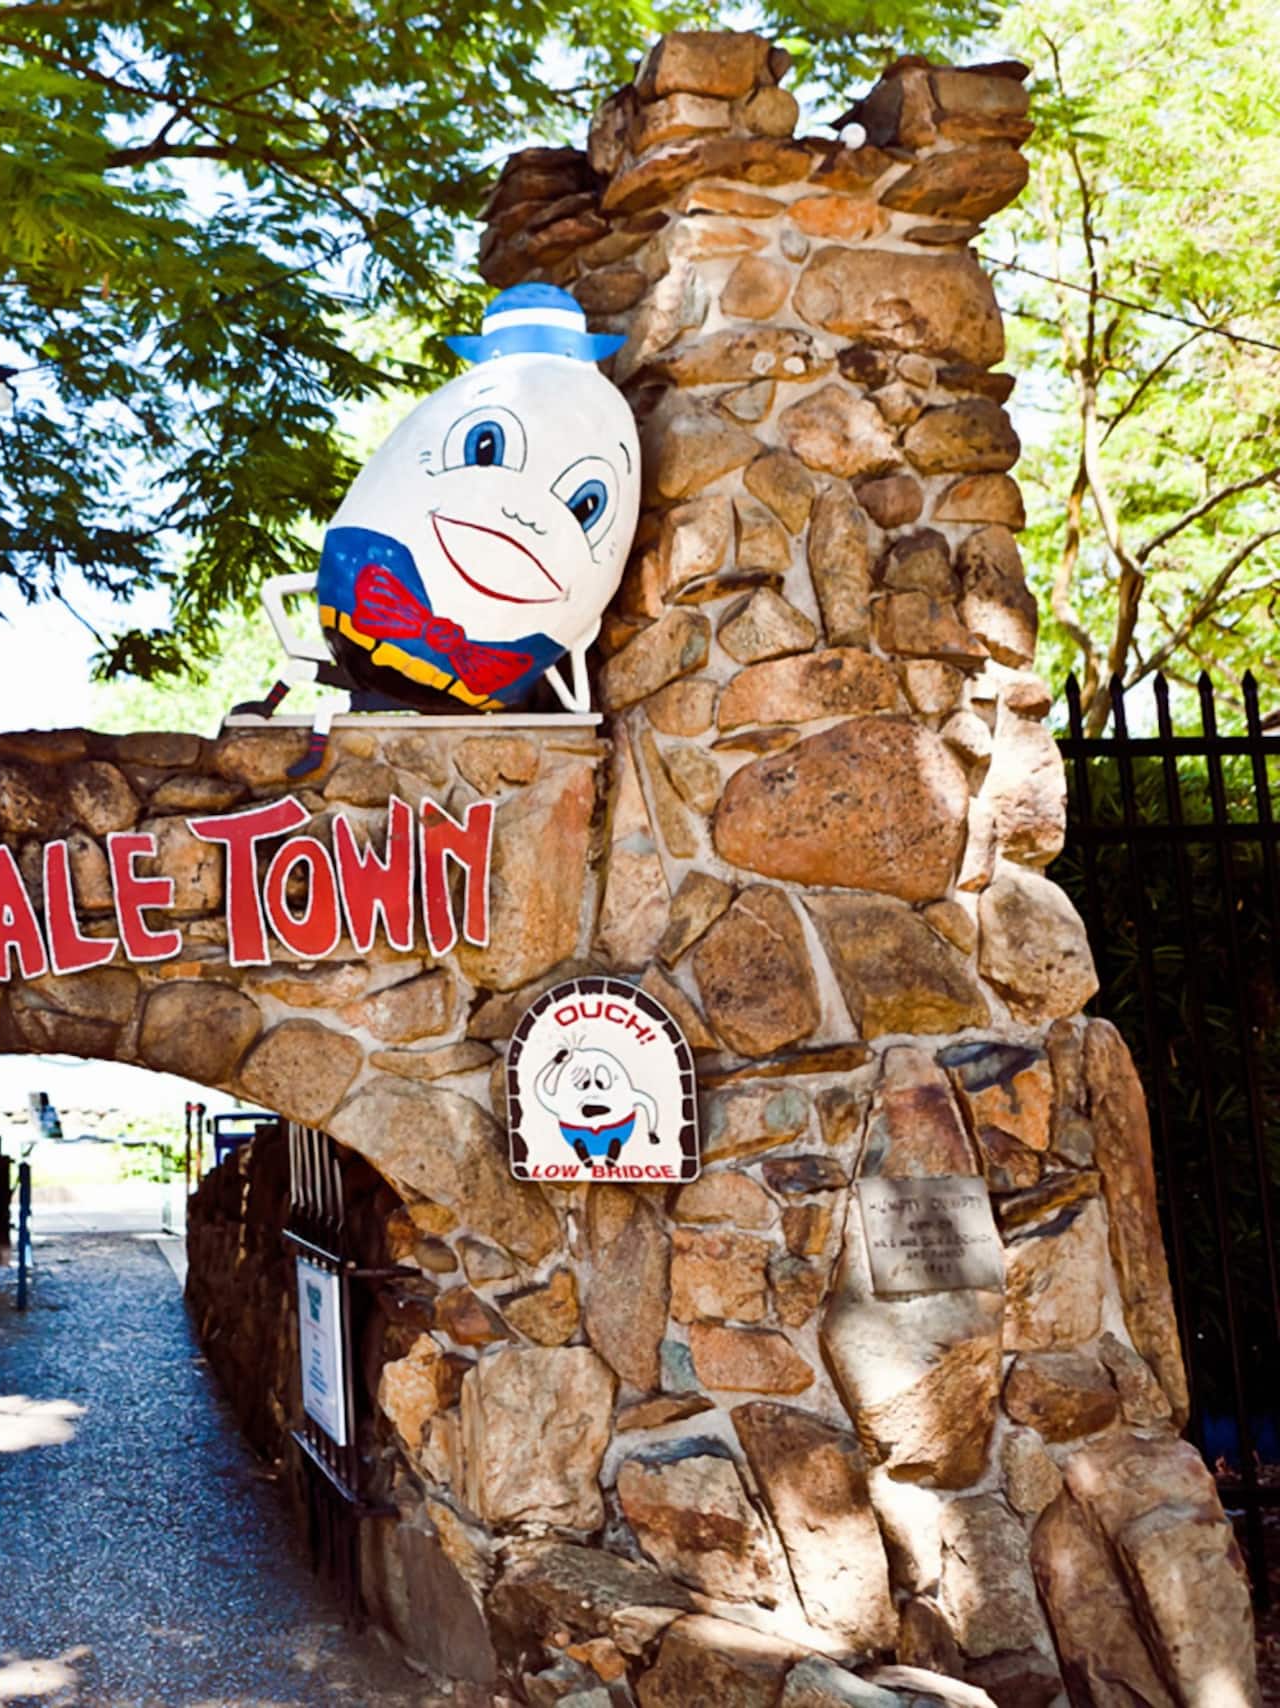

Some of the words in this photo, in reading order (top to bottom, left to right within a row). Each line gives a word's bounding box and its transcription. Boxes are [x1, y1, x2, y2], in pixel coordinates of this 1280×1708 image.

[187, 795, 496, 966] TOWN
[553, 1001, 657, 1046] OUCH!
[531, 1164, 580, 1179] LOW
[591, 1164, 679, 1179] BRIDGE
